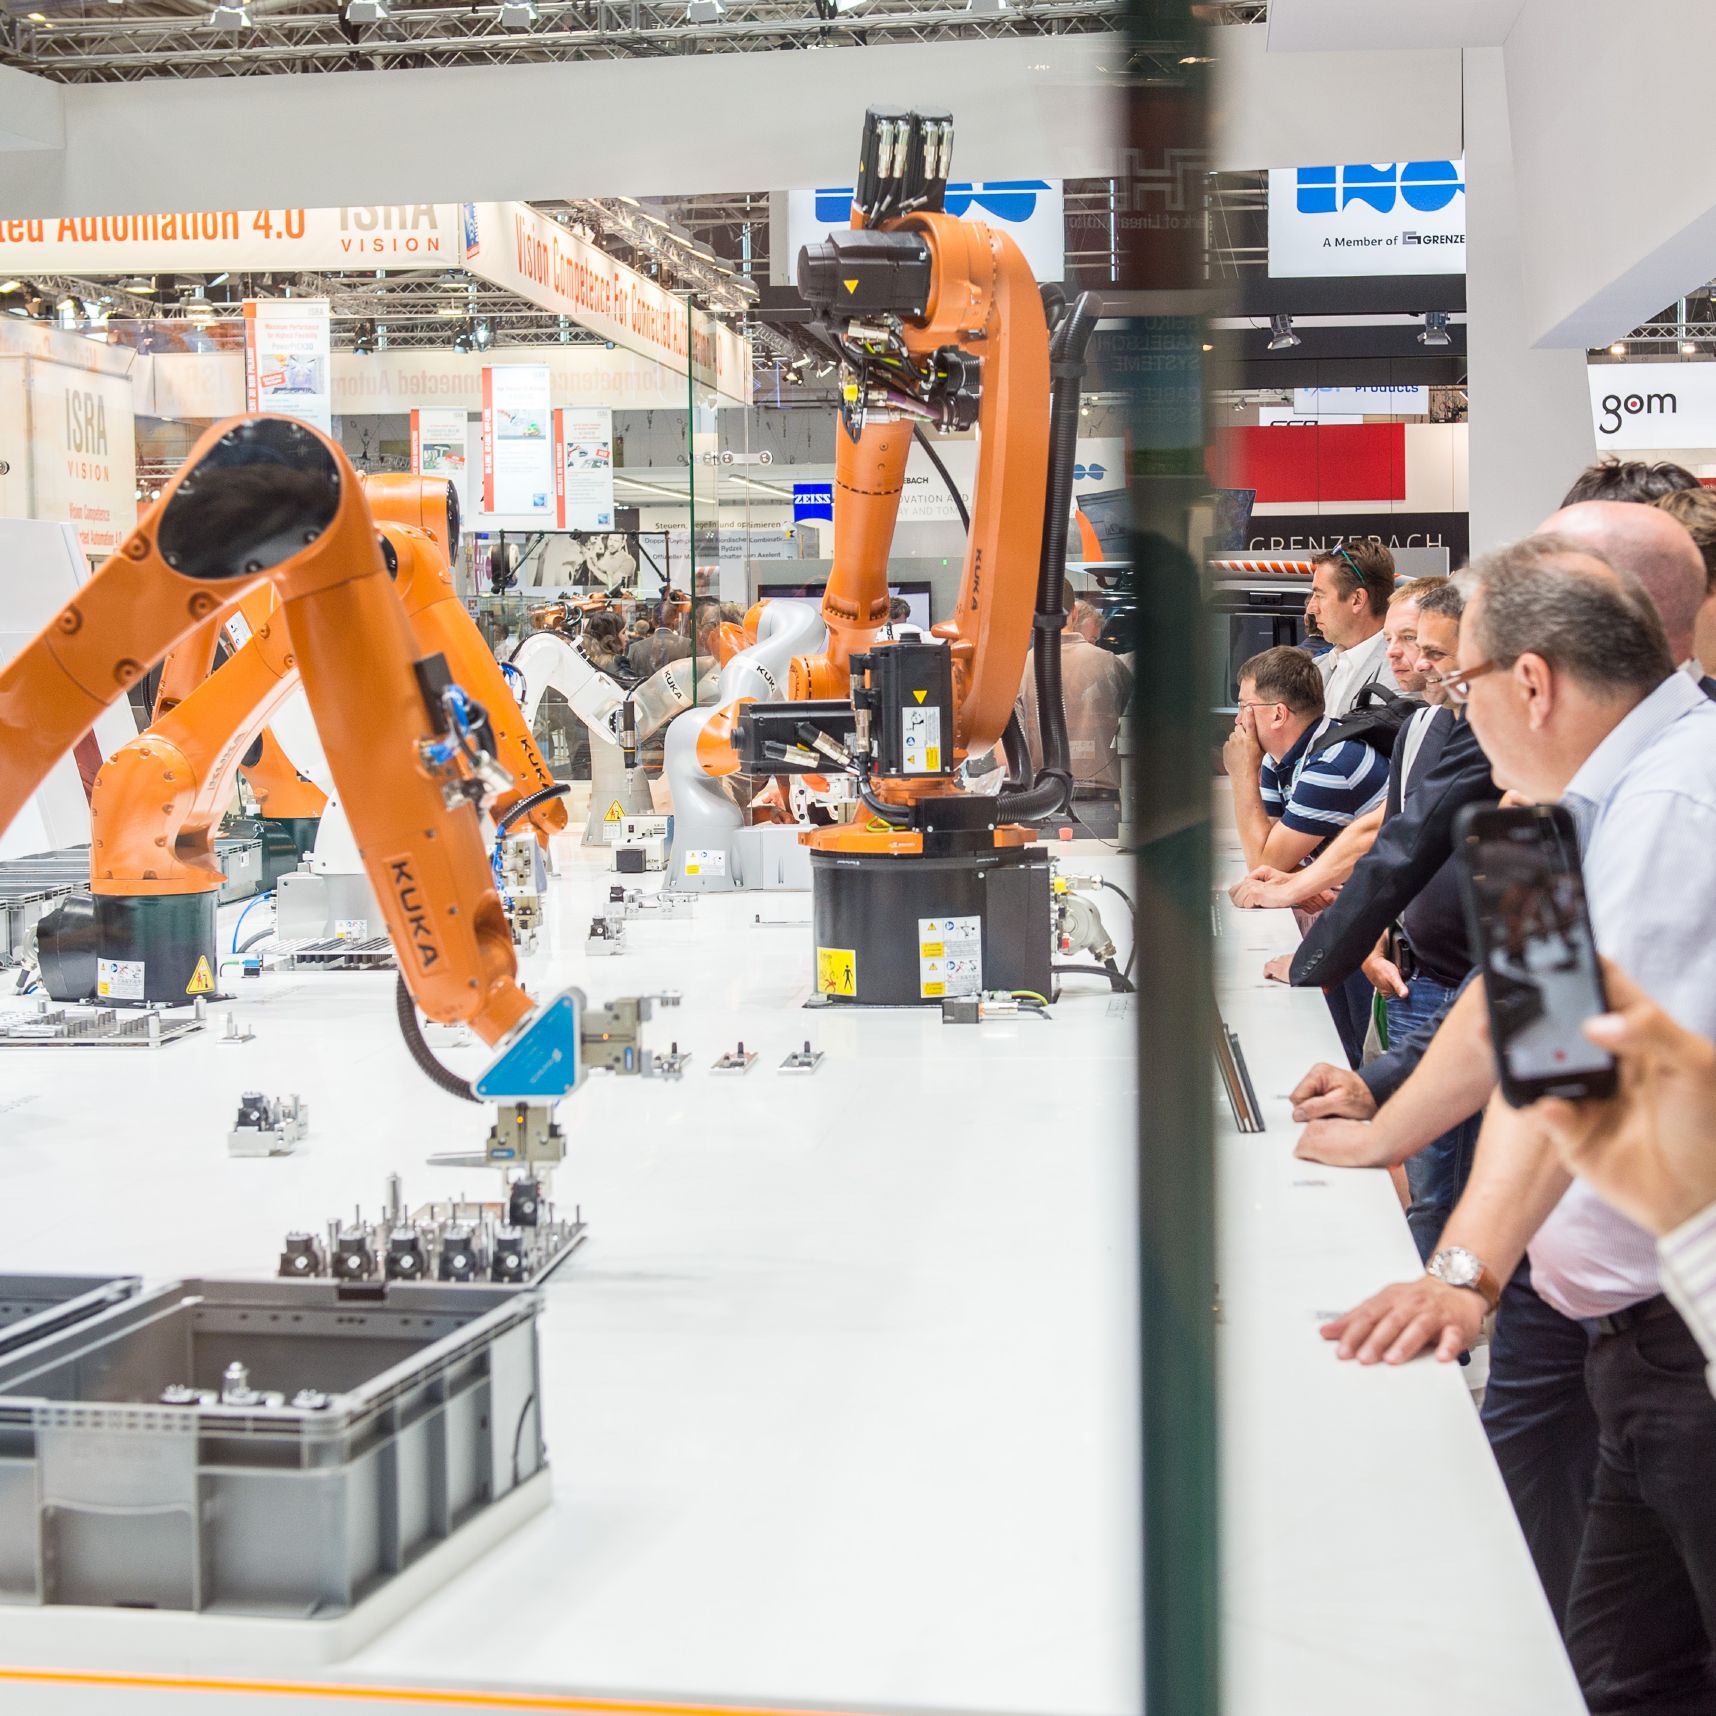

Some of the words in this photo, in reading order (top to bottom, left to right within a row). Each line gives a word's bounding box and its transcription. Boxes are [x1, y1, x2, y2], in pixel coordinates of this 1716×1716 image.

[341, 238, 440, 252] VISION
[1323, 238, 1332, 247] A
[1335, 236, 1383, 247] Member
[1386, 235, 1399, 246] of
[515, 212, 549, 288] Vision
[553, 235, 611, 317] Competence
[614, 272, 628, 327] For
[631, 282, 671, 350] Connected
[65, 388, 108, 456] ISRA
[1599, 393, 1677, 434] gom
[68, 461, 110, 481] VISION
[793, 493, 832, 504] ZEISS
[947, 494, 969, 503] AD
[664, 670, 683, 700] KUKA
[391, 860, 440, 968] KUKA
